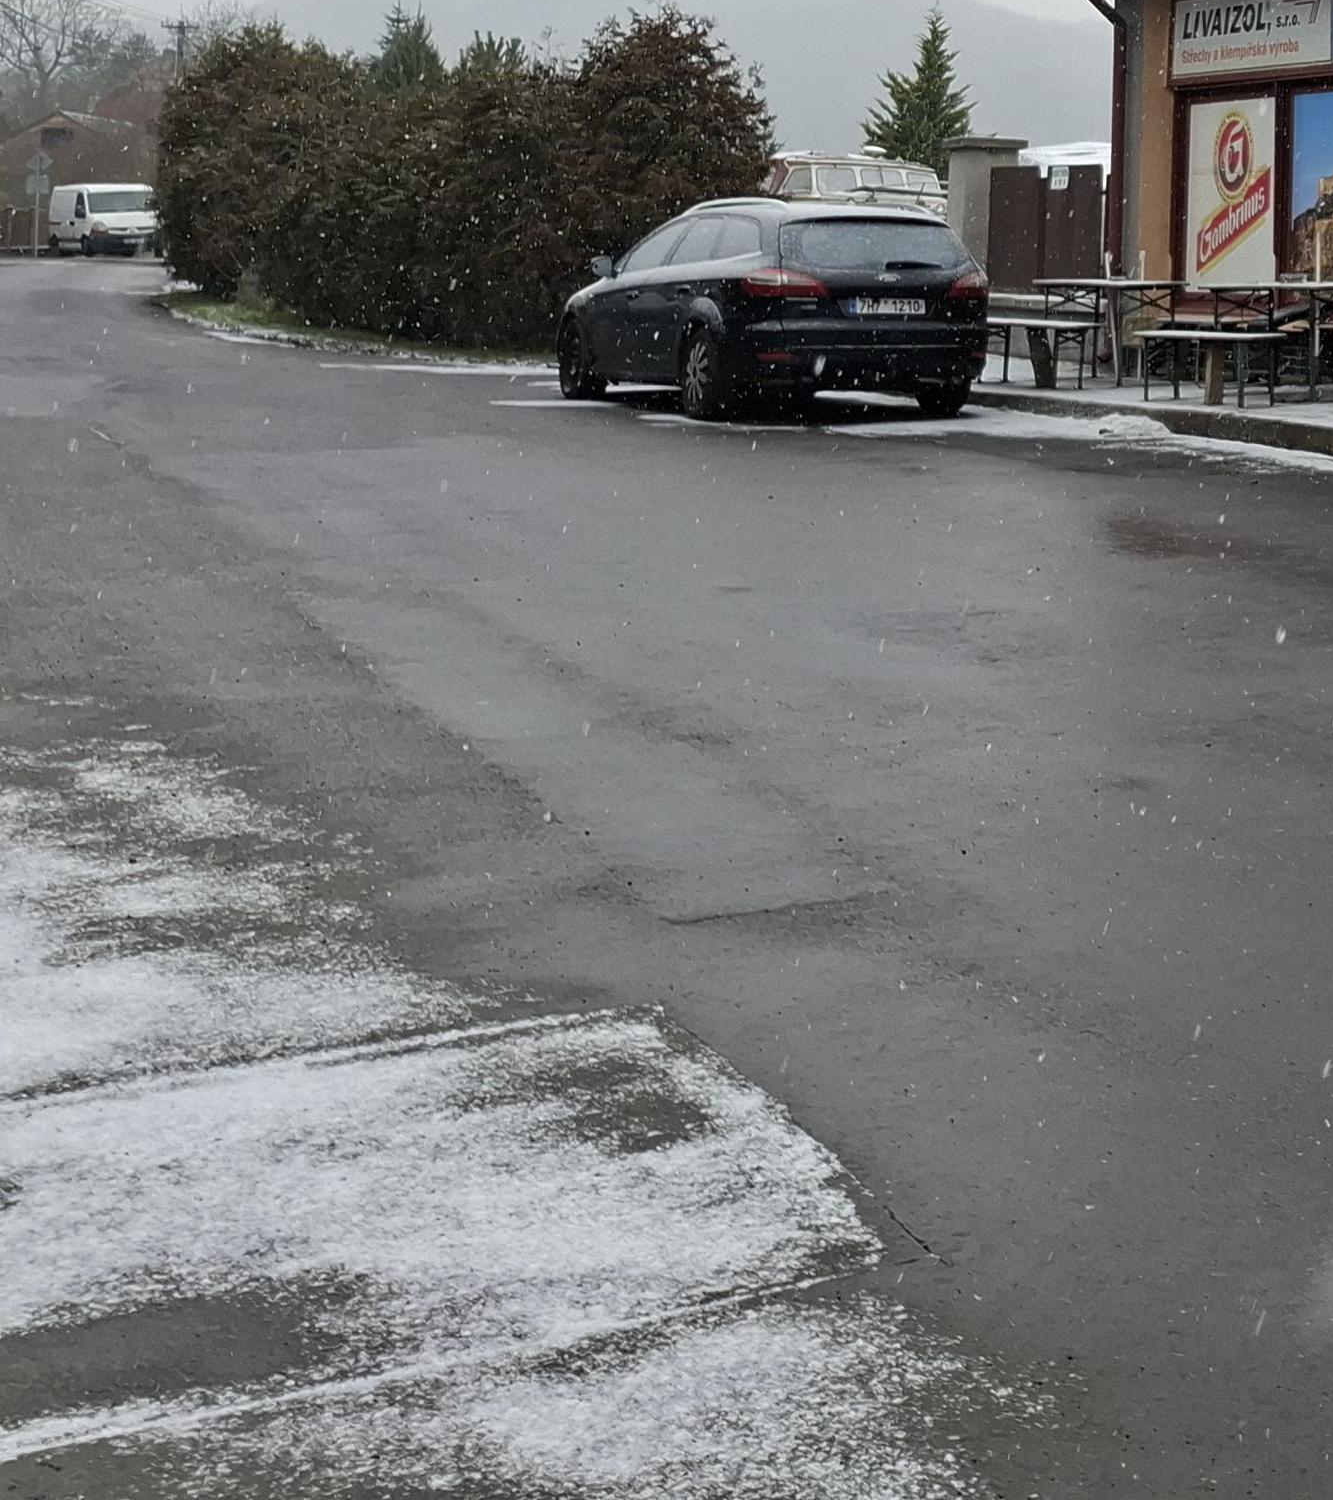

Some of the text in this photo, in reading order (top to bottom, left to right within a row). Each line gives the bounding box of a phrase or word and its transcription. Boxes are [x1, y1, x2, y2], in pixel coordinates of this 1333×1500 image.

[1276, 14, 1301, 28] s.r.o.
[1269, 38, 1300, 57] výroba
[1200, 186, 1265, 263] Gambrinus
[892, 300, 920, 312] 1210
